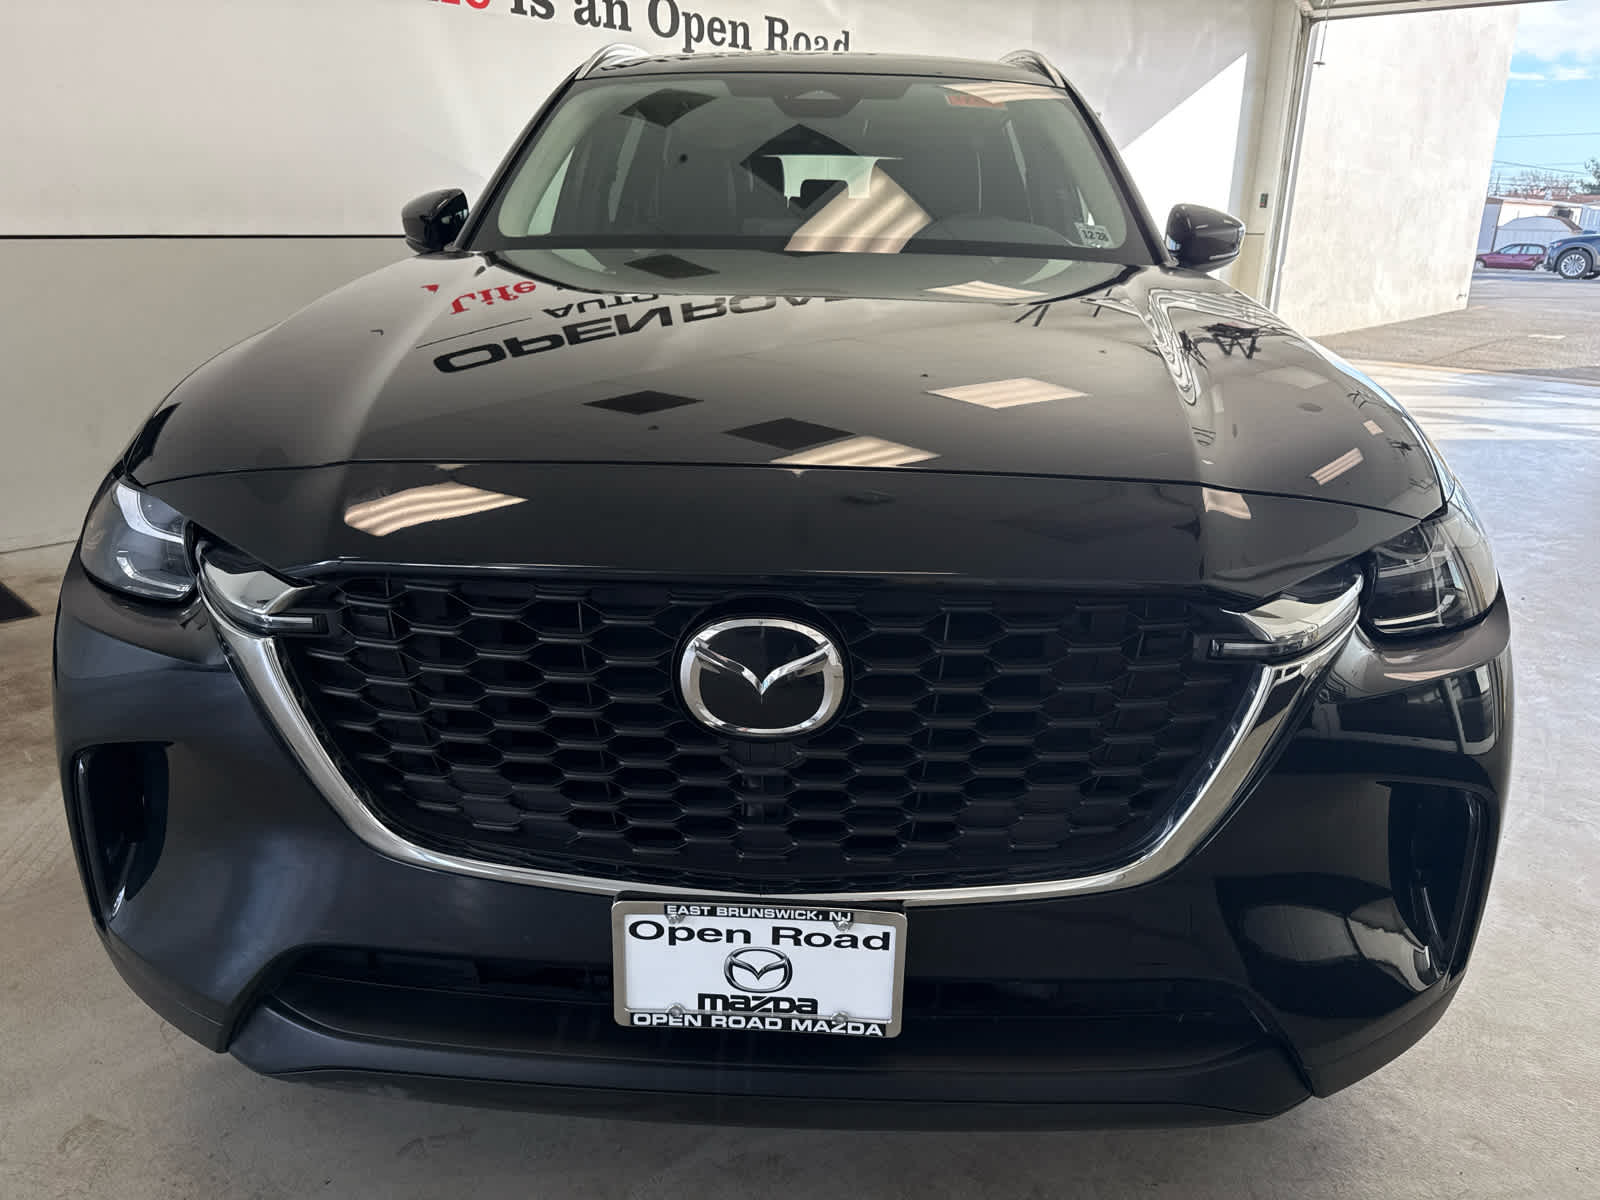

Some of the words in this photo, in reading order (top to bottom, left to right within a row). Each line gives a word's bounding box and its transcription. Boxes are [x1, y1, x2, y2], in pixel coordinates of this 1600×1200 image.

[574, 0, 632, 32] an
[647, 0, 752, 53] Open
[667, 905, 711, 916] EAST
[829, 912, 852, 922] NJ
[628, 920, 752, 946] Open
[771, 926, 891, 951] Road
[633, 1013, 702, 1027] OPEN
[711, 1015, 783, 1031] ROAD
[791, 1019, 884, 1037] MAZDA
